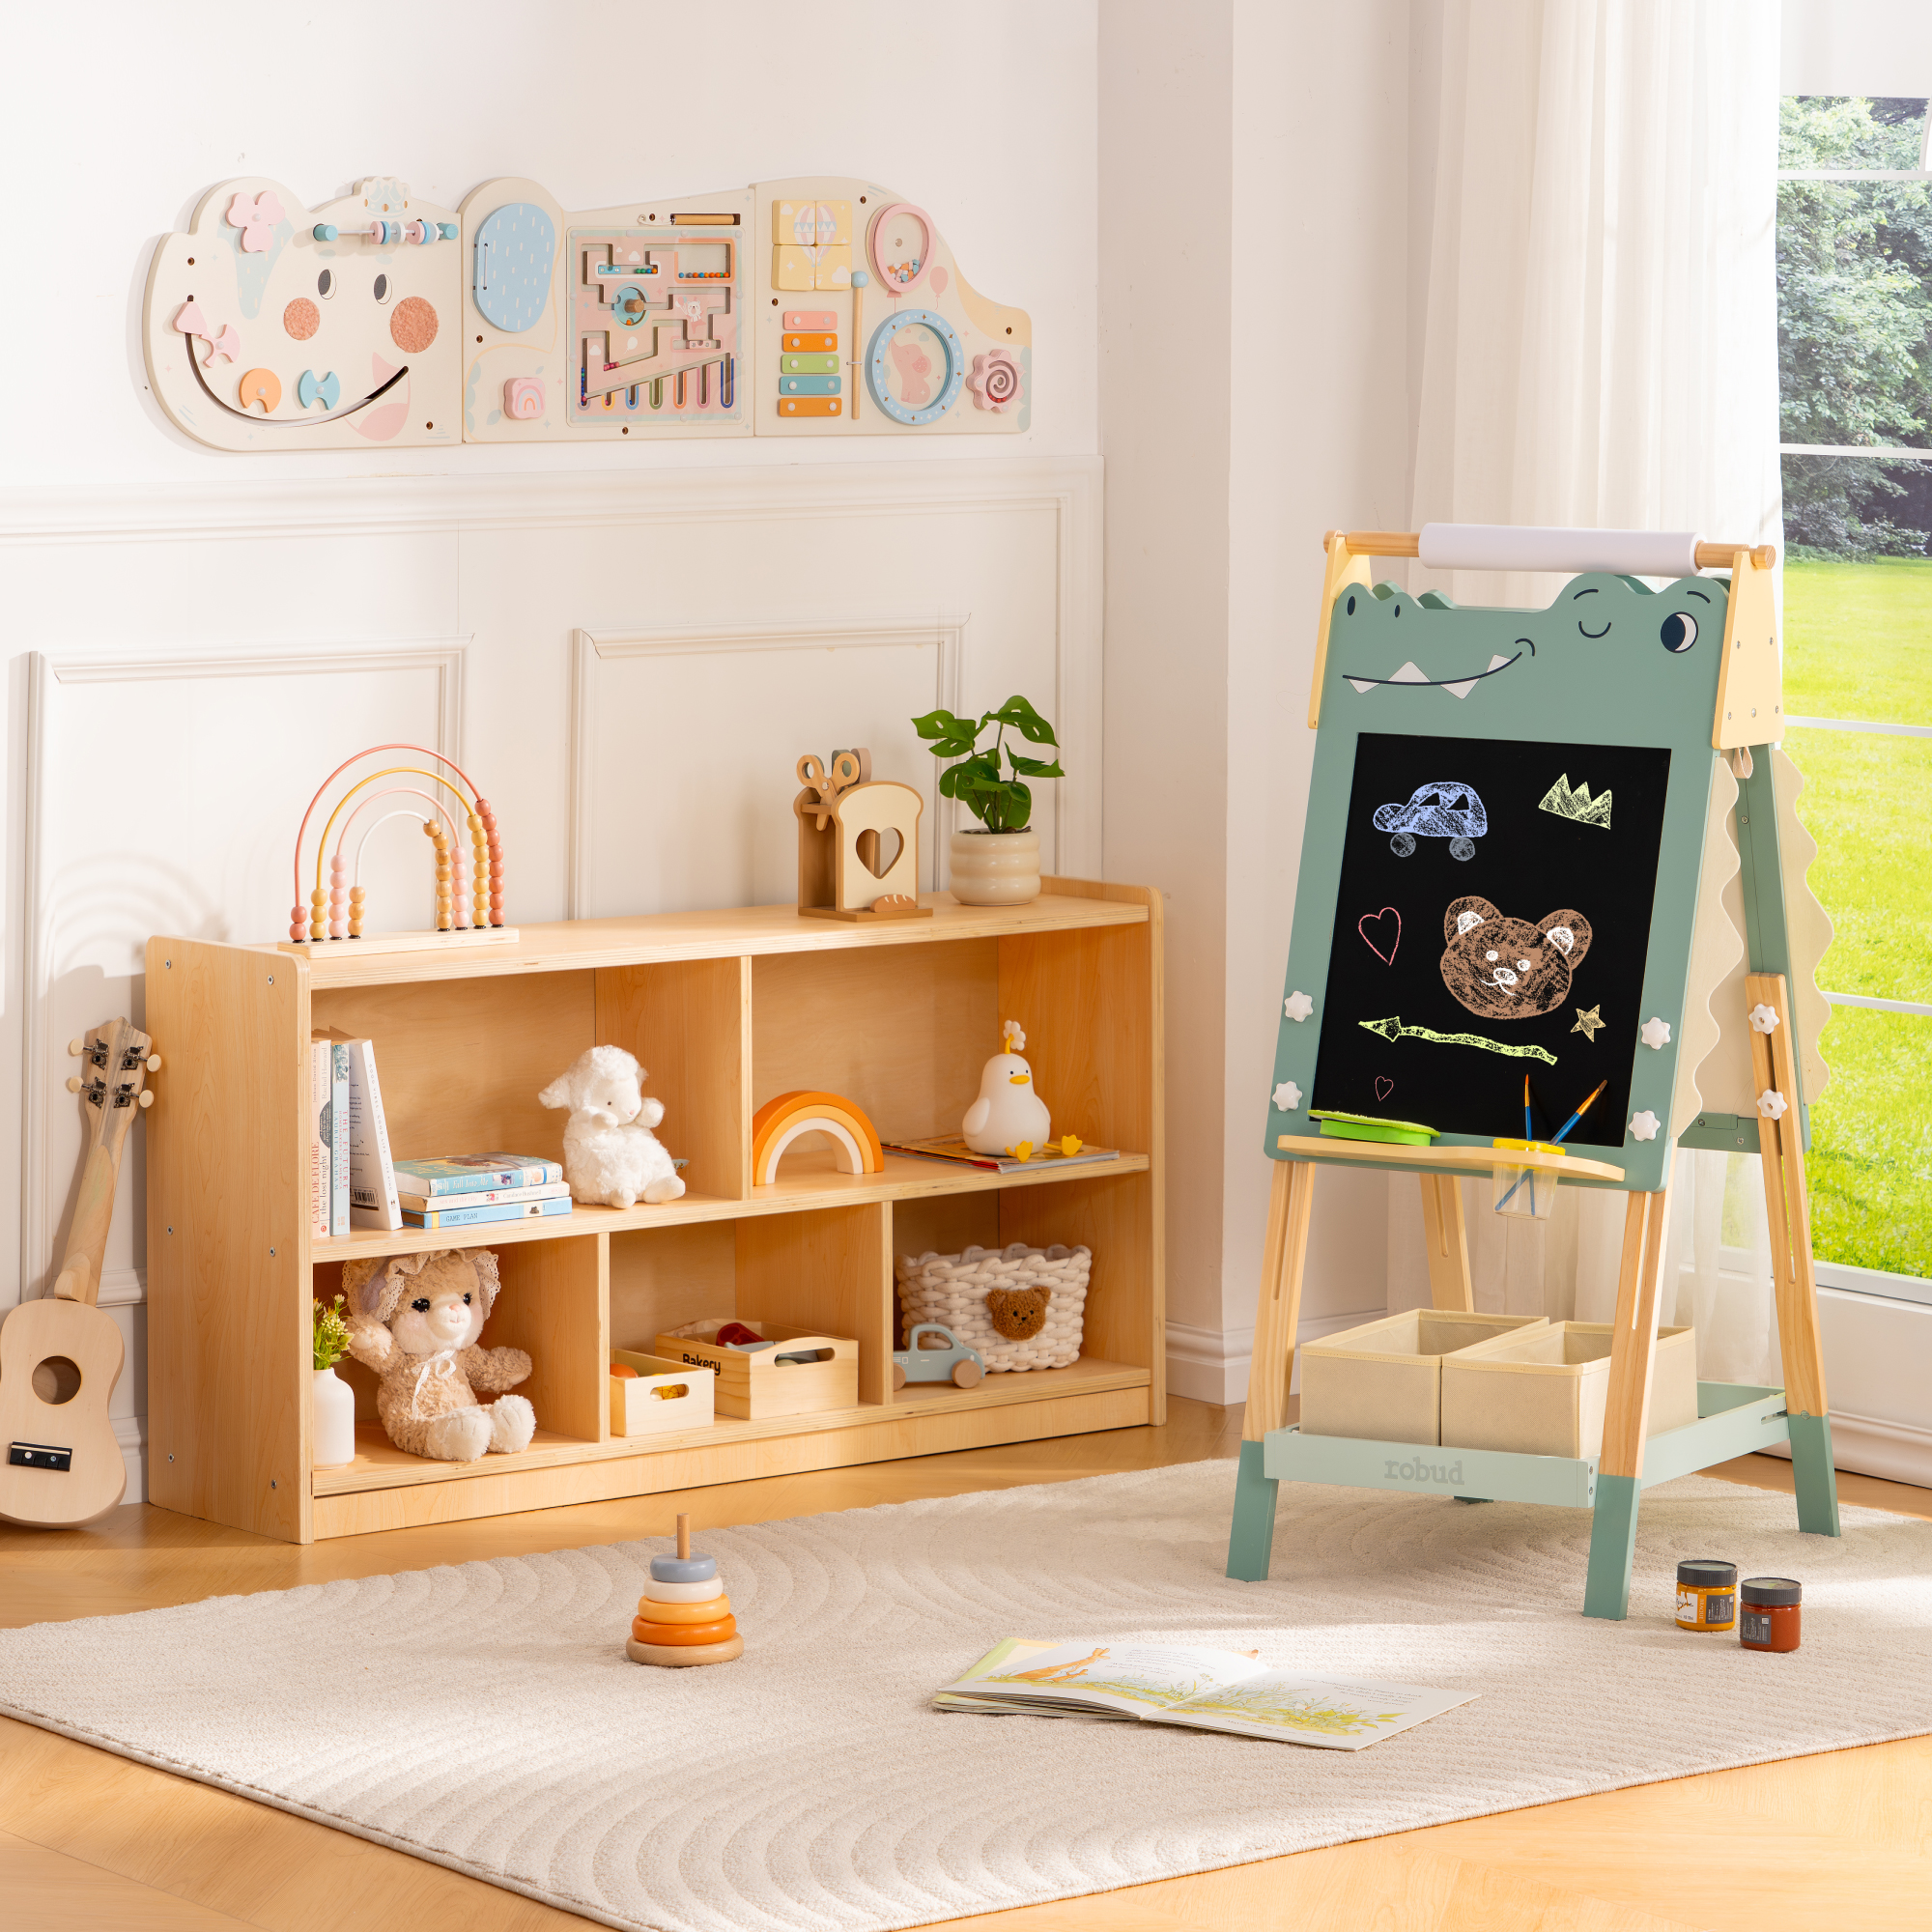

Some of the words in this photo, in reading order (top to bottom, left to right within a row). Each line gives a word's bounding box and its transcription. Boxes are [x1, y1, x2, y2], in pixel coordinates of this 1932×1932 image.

[320, 1156, 328, 1179] night
[312, 1179, 319, 1193] DE
[453, 1179, 464, 1189] Fall
[466, 1179, 477, 1187] Into
[477, 1175, 489, 1187] Me
[682, 1353, 721, 1376] Bakery
[1383, 1456, 1464, 1485] robud
